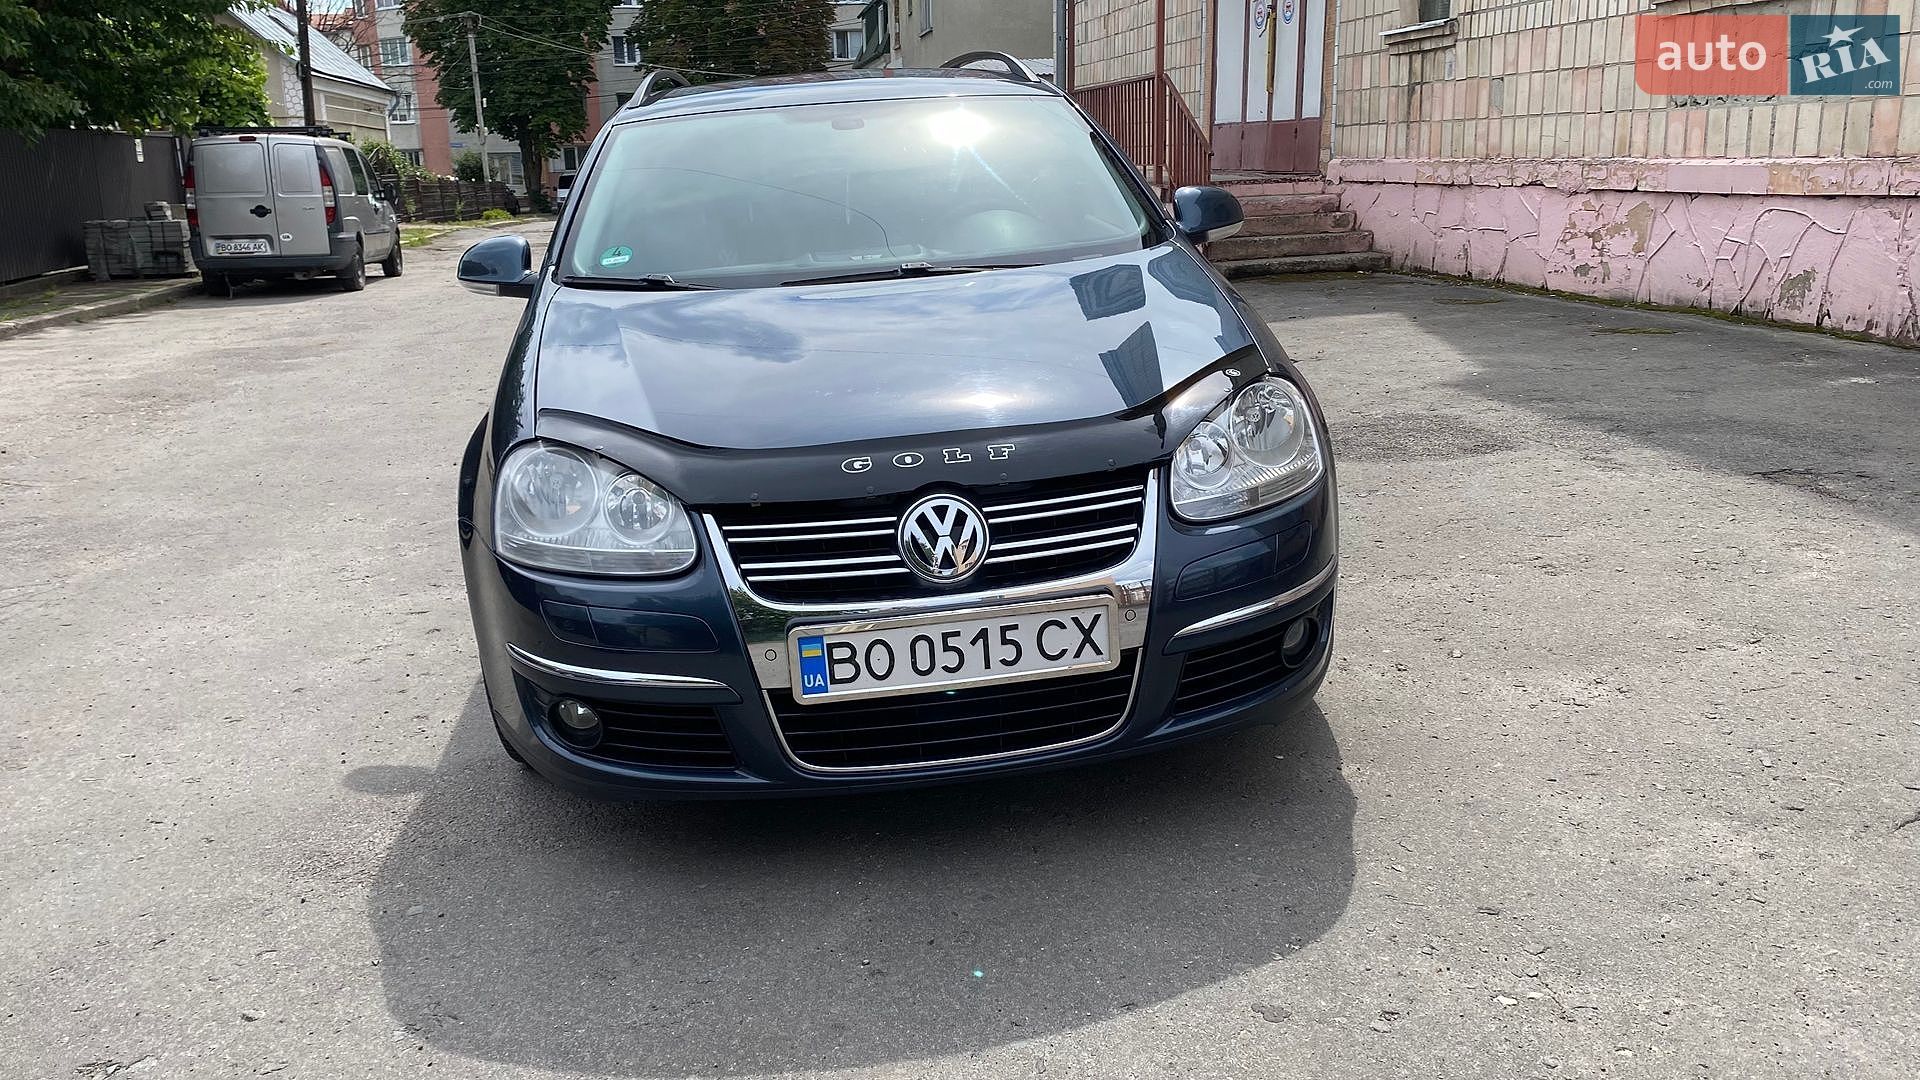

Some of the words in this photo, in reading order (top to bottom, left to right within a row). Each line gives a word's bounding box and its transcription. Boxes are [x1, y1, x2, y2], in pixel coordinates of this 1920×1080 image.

[841, 444, 1015, 473] GOLF
[826, 638, 895, 685] BO
[909, 624, 1024, 677] 0515
[1036, 613, 1104, 661] CX
[804, 674, 825, 688] UA
